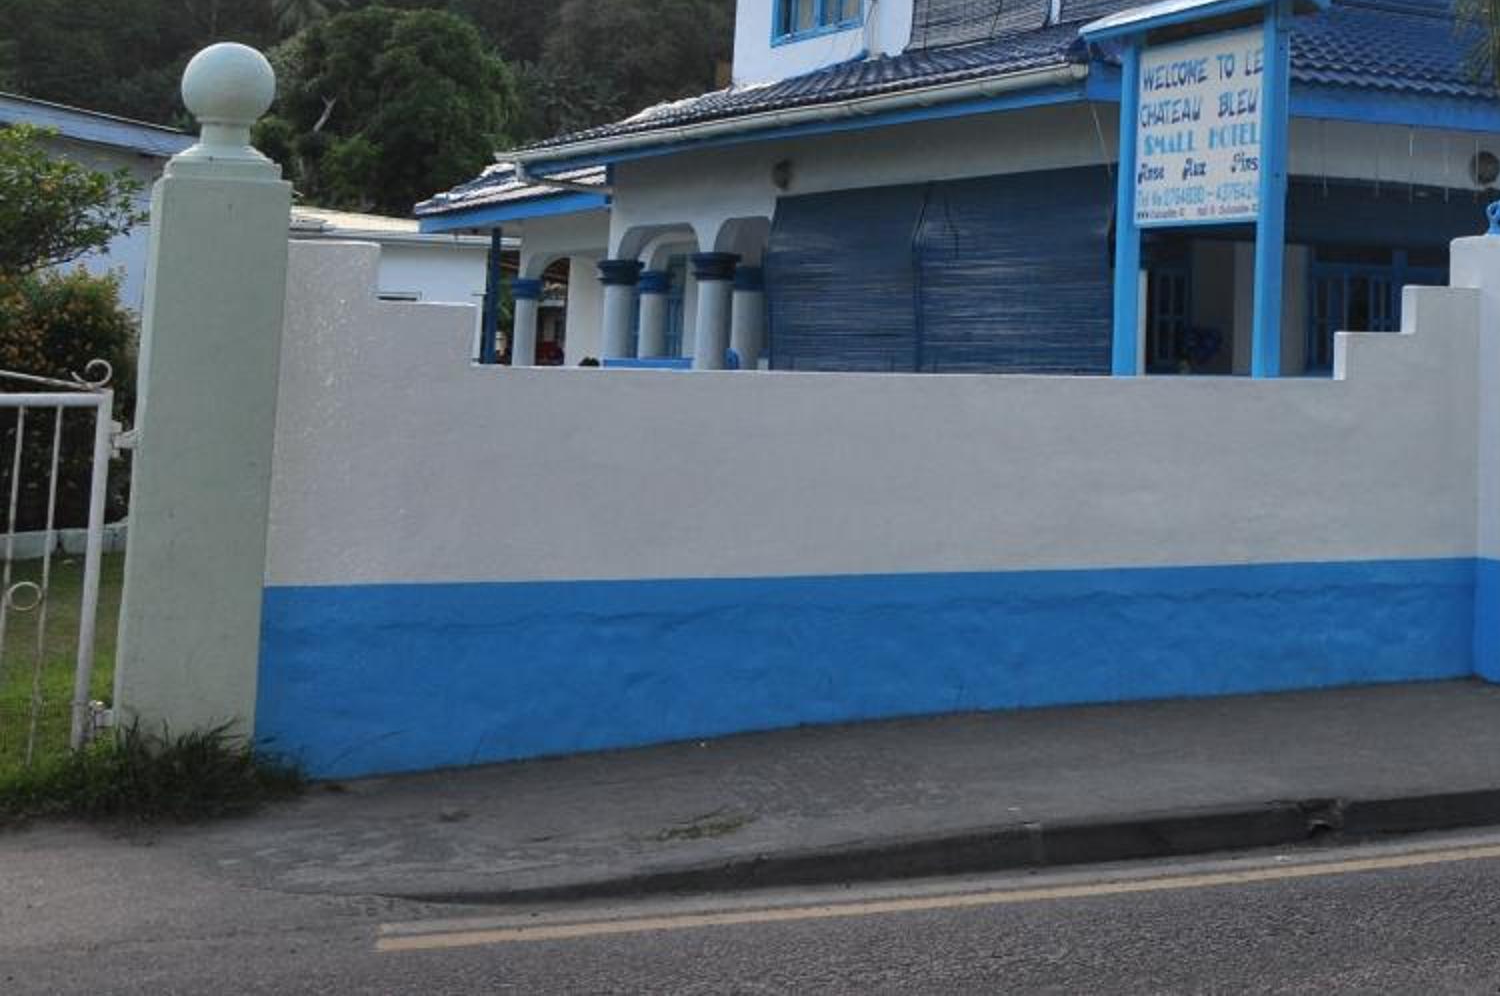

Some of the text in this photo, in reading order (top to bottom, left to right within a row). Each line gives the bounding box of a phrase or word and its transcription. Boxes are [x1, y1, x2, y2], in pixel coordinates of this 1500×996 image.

[1143, 48, 1264, 90] WELCOME TO LE
[1140, 88, 1259, 128] CHATEAU BLEU
[1144, 122, 1260, 156] SMALL HOTEL
